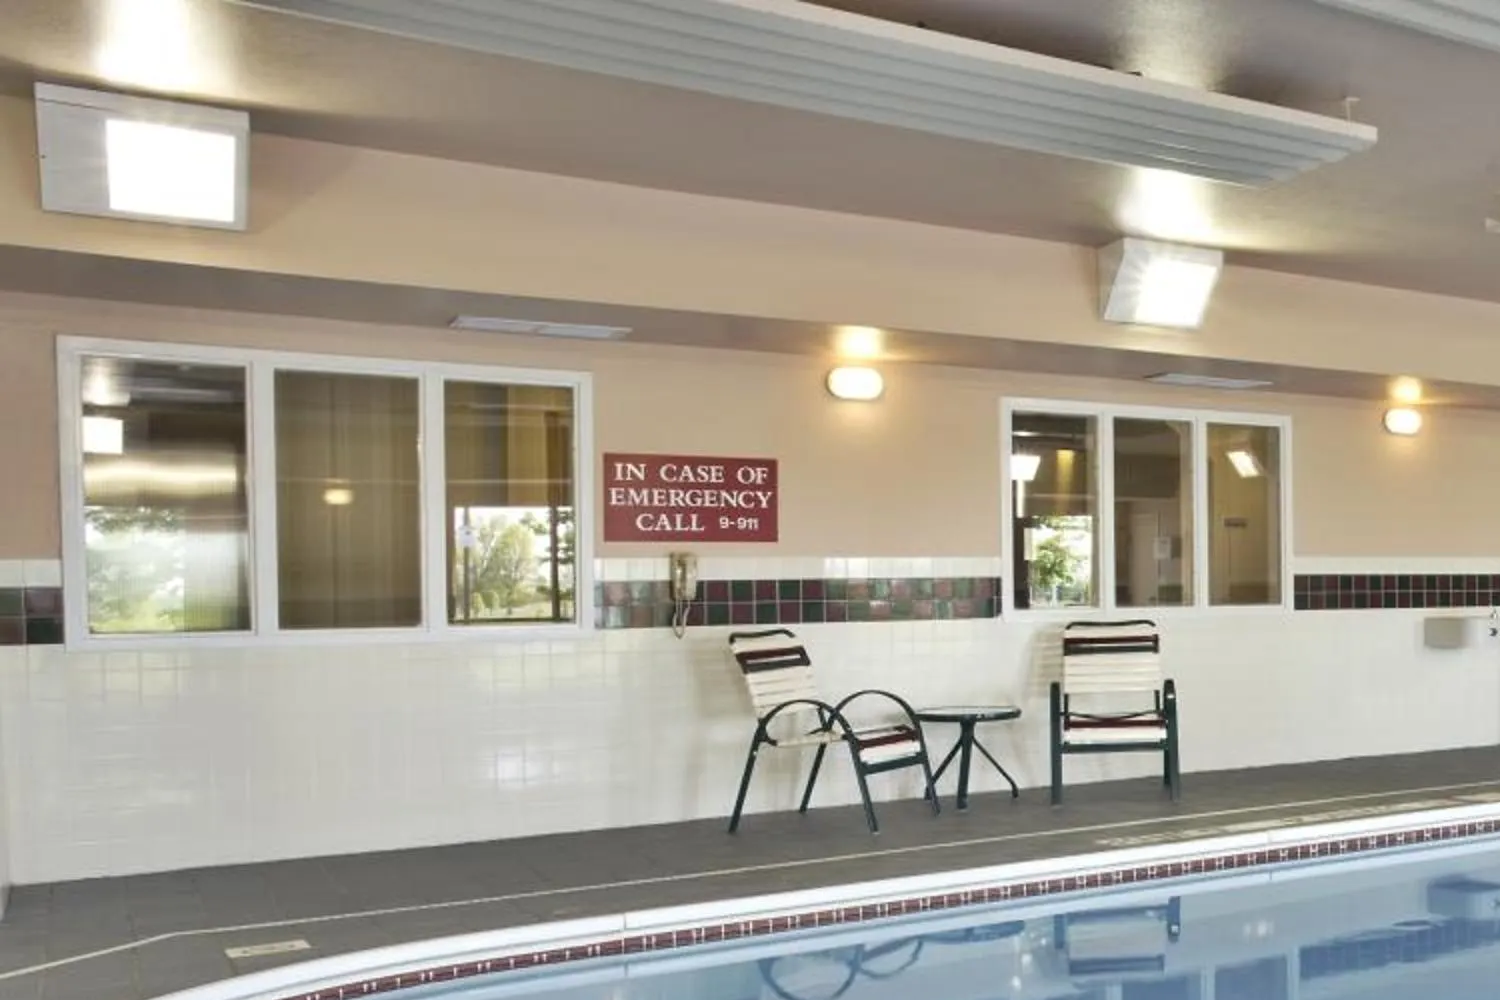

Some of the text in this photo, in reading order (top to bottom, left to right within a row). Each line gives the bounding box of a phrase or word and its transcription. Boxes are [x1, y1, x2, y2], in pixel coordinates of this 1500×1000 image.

[614, 462, 769, 484] IN CASE OF
[609, 487, 773, 509] EMERGENCY
[635, 513, 759, 531] CALL 9-911
